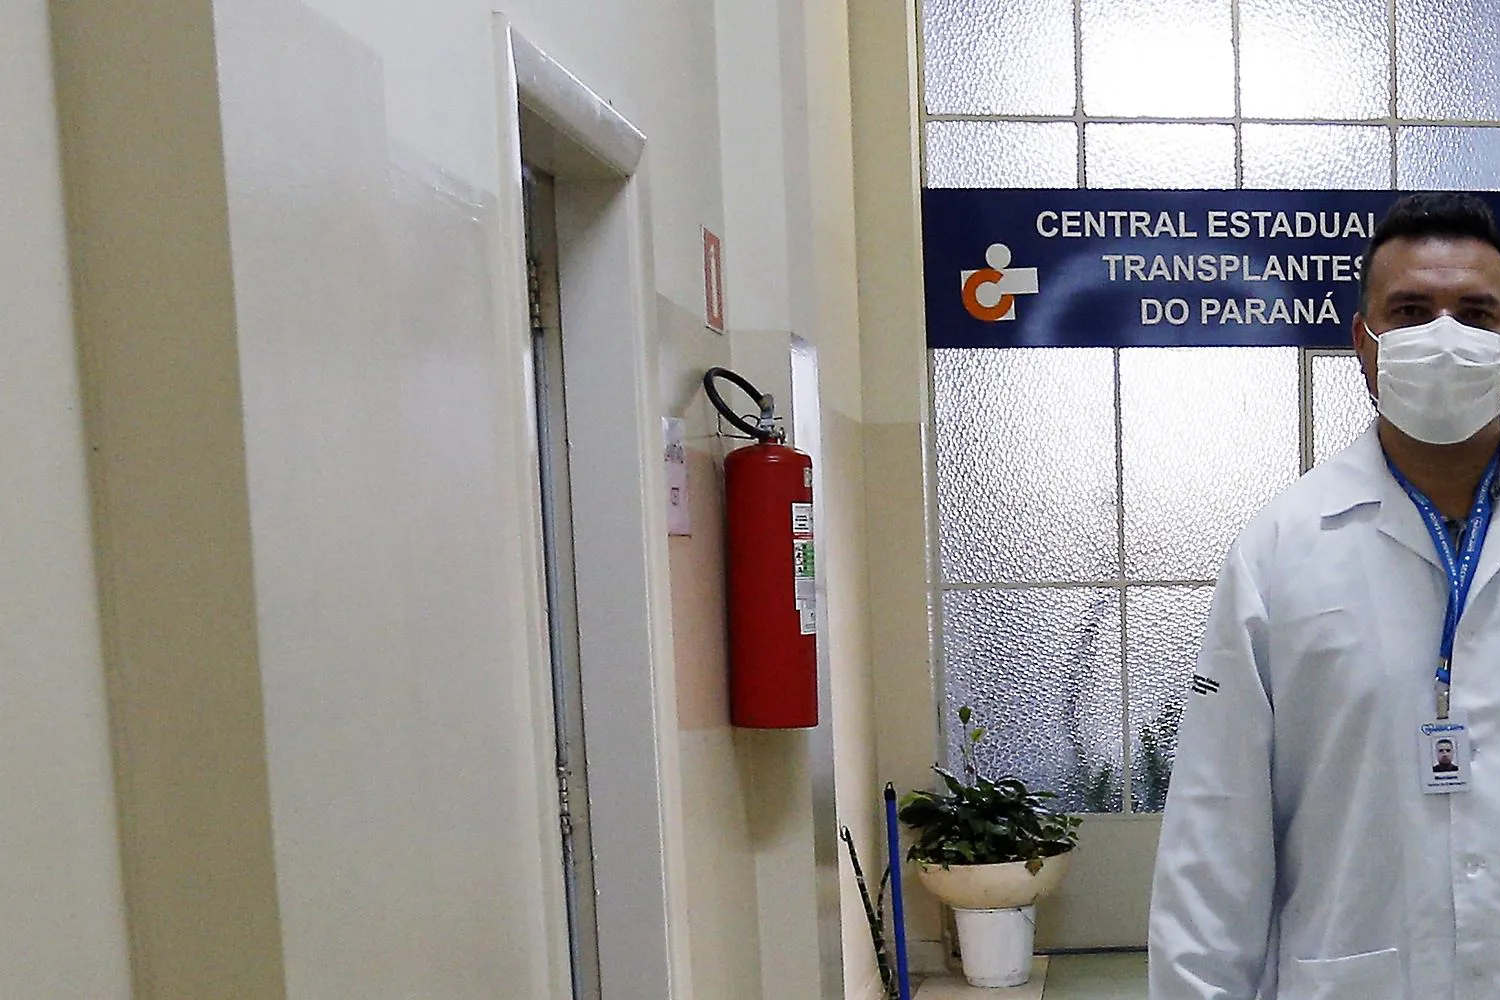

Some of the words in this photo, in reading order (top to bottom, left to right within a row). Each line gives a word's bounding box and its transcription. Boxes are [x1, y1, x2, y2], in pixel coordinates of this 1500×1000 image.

[1036, 210, 1198, 238] CENTRAL
[1207, 210, 1376, 238] ESTADUAL
[1141, 297, 1190, 325] DO
[1201, 291, 1341, 325] PARANÁ
